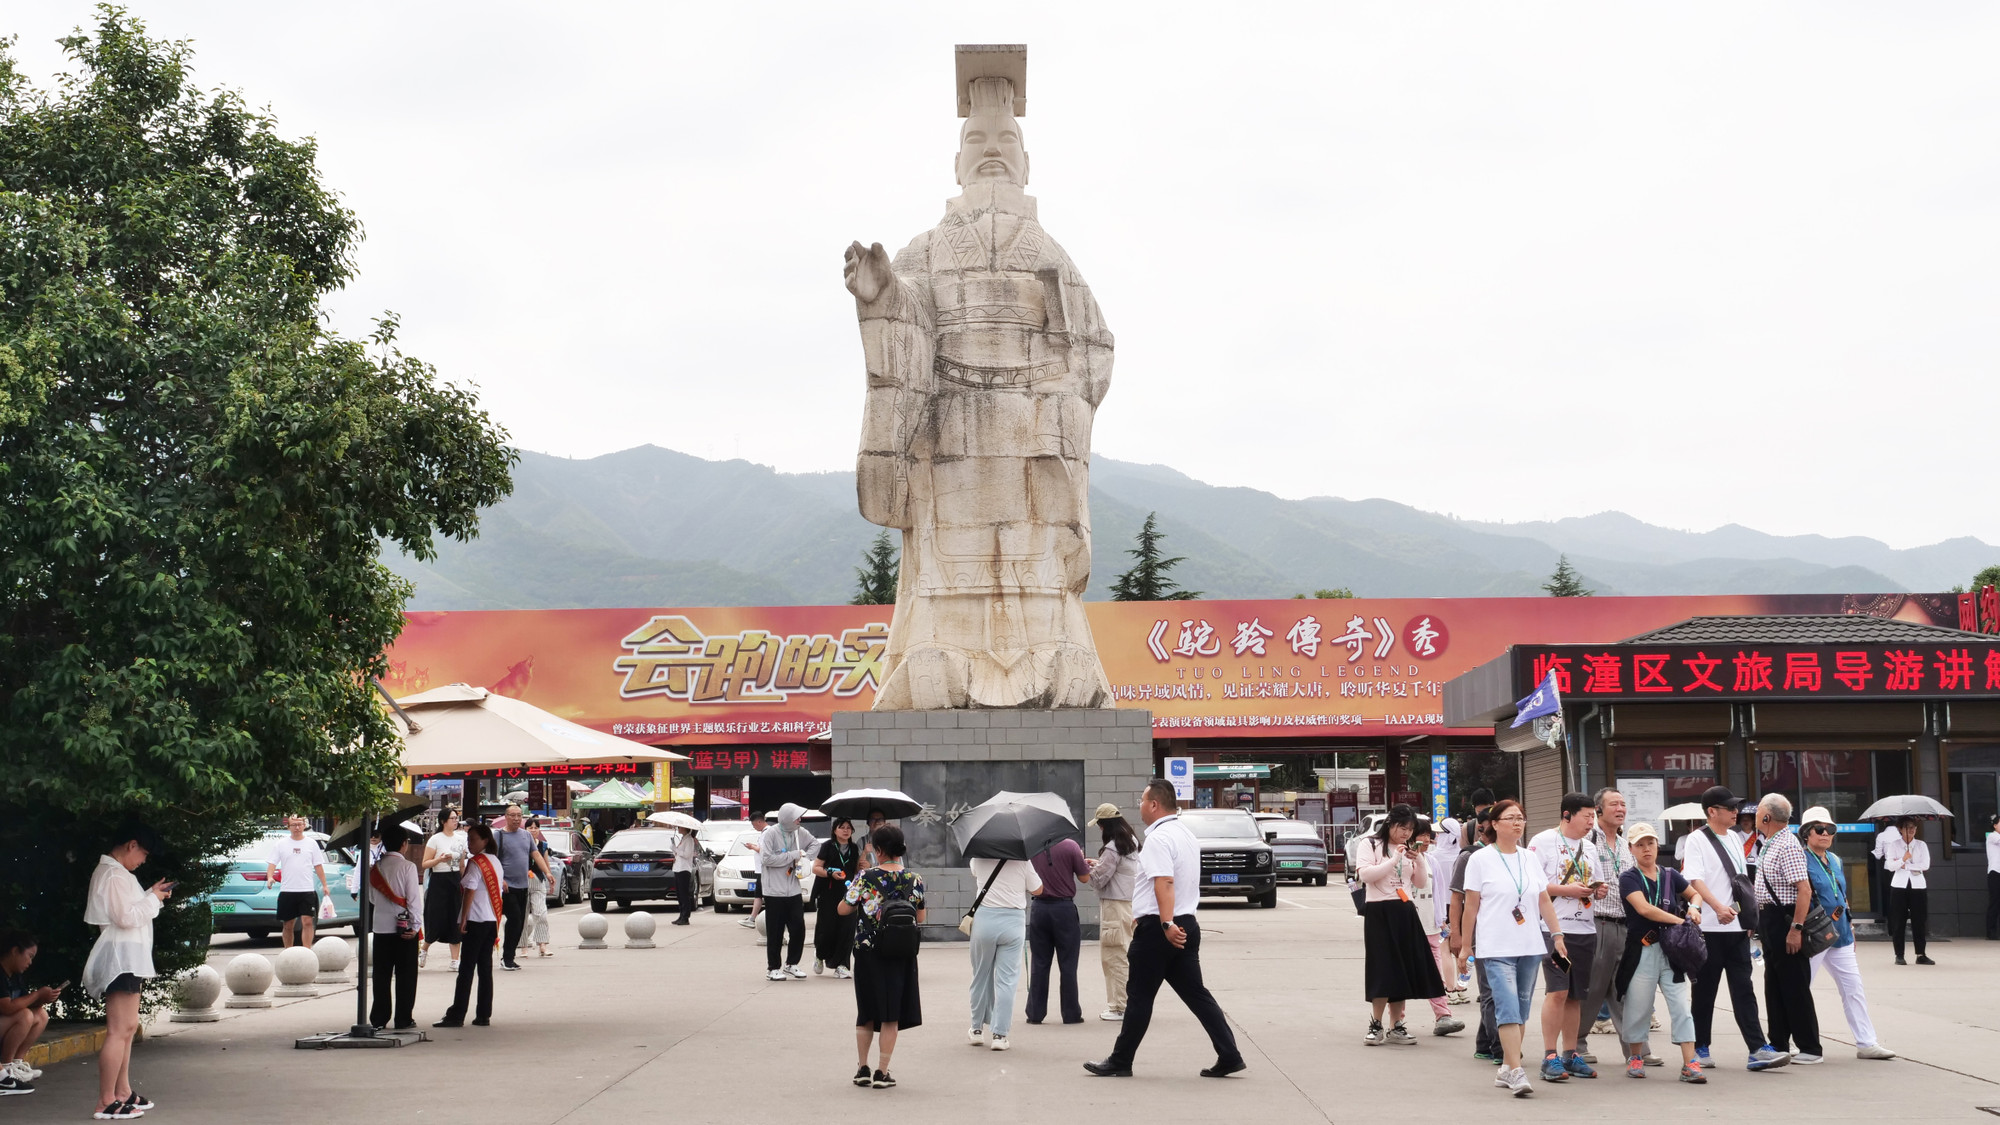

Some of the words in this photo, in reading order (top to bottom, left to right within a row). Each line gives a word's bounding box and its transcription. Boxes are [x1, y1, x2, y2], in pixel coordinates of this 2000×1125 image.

[1410, 616, 1440, 656] 秀
[1176, 666, 1224, 679] TUO
[1242, 666, 1303, 678] LING
[1320, 664, 1420, 678] LEGEND
